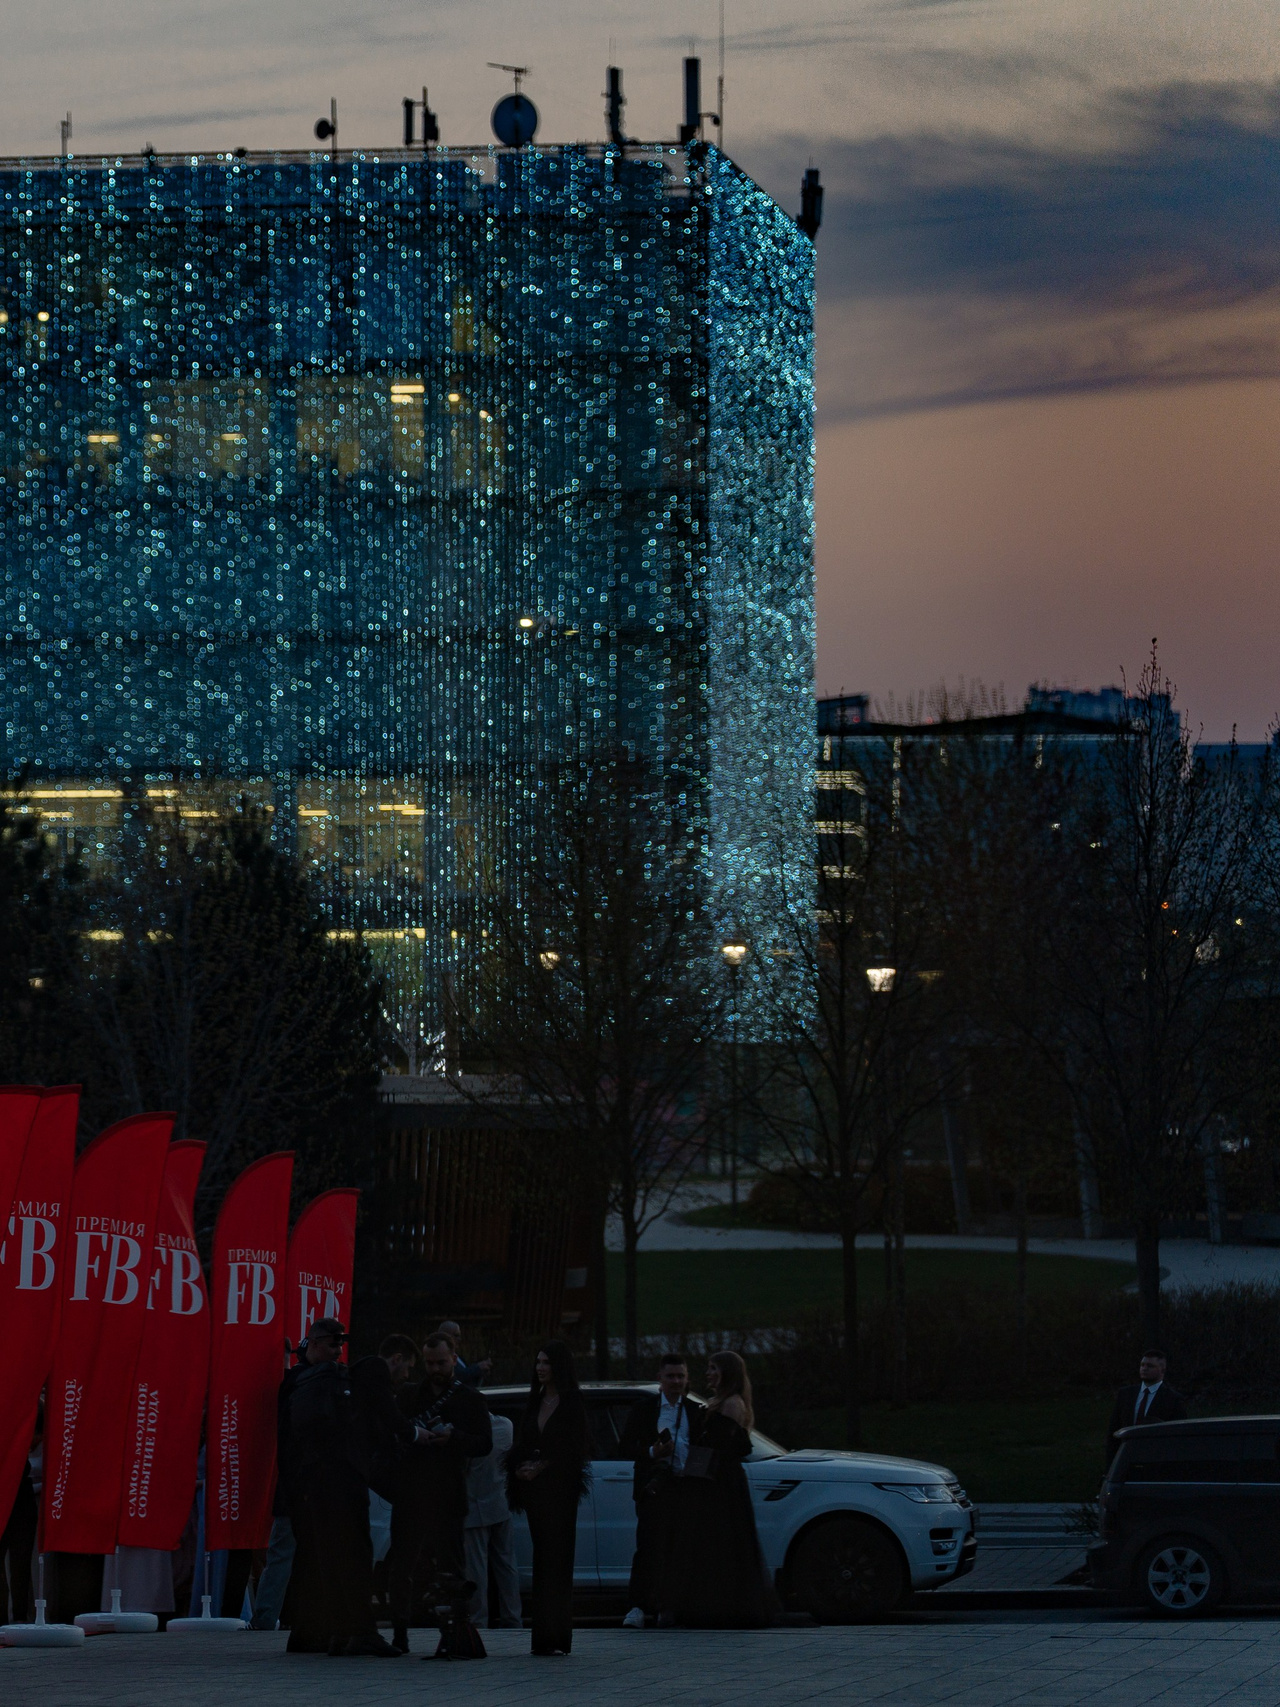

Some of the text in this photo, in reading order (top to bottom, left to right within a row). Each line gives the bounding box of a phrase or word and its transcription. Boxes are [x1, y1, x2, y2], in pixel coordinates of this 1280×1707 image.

[76, 1216, 146, 1237] ПРЕМИЯ
[228, 1249, 277, 1264] ПРЕМИЯ
[69, 1231, 142, 1305] FB
[223, 1262, 276, 1325] FB
[128, 1383, 149, 1517] САМОЕ МОДНОЕ
[138, 1389, 160, 1518] СОБЫТИЕ ГОДА
[229, 1443, 240, 1521] СОБЫТИЕ
